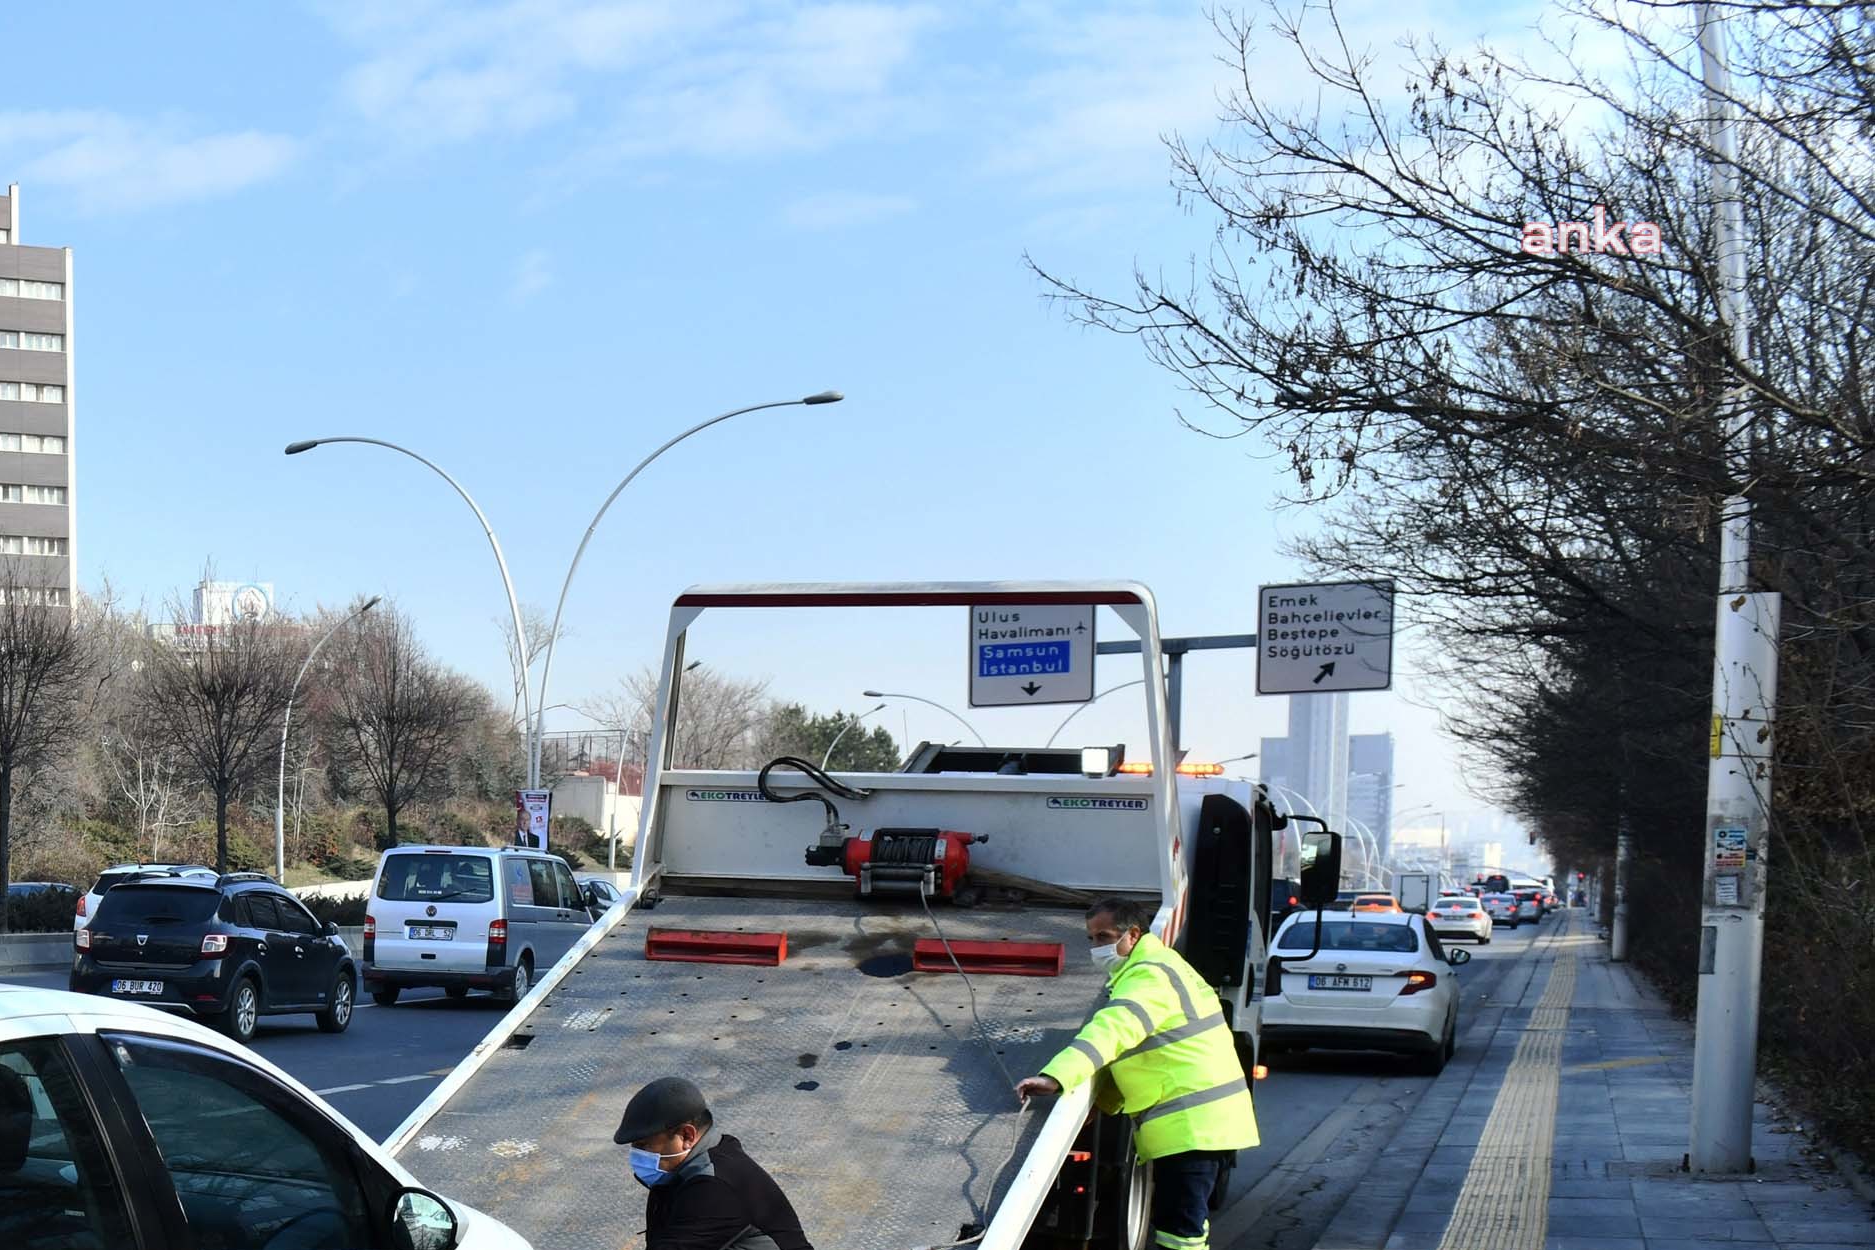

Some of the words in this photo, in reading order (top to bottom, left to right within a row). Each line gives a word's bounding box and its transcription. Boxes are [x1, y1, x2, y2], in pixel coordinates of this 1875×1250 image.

[1268, 594, 1318, 608] Emek
[978, 611, 1021, 624] Ulus
[1268, 608, 1381, 625] Bahçelievler
[978, 626, 1070, 640] Havalimanı
[1267, 627, 1340, 641] Beştepe
[983, 646, 1059, 658] Samsun
[1267, 643, 1355, 660] Söğütözü
[983, 659, 1062, 675] İstanbul
[700, 791, 766, 801] EKOTREYLE
[1062, 798, 1143, 809] EKOTREYLER
[117, 980, 126, 990] 06
[147, 982, 162, 992] 420
[1315, 976, 1327, 986] 06
